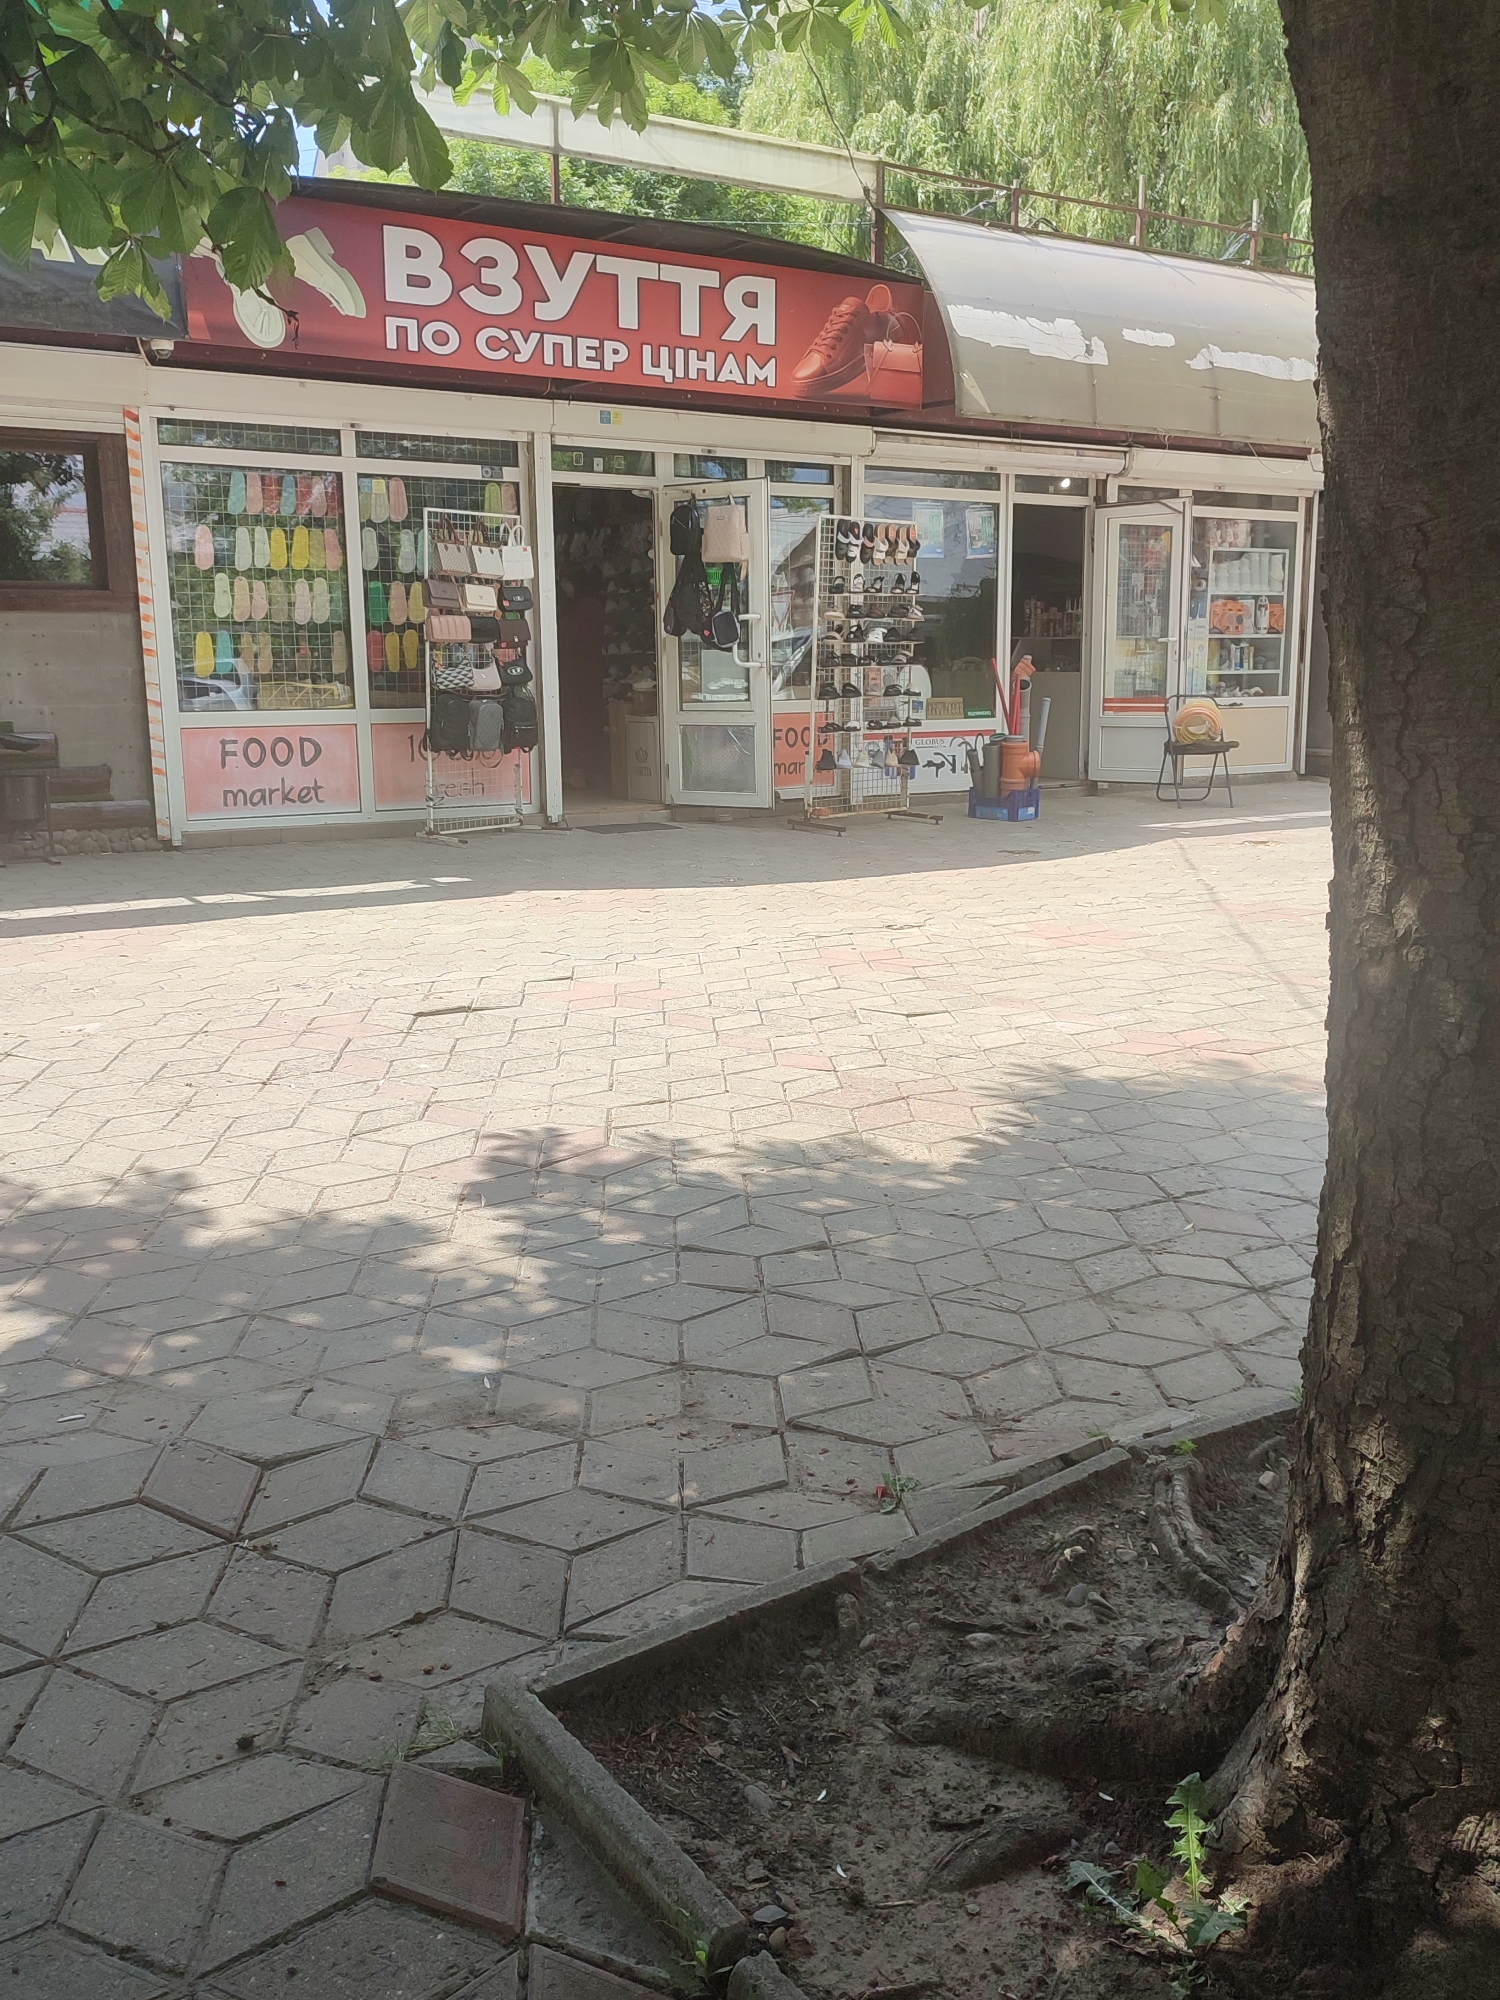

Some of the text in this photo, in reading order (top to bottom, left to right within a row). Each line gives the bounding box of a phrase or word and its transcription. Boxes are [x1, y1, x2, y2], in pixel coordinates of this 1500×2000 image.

[382, 224, 777, 346] ВЗУТТЯ
[385, 316, 777, 387] ПО СУПЕР ЦІНАМ
[219, 736, 323, 769] FOOD
[915, 738, 945, 746] GLOBUS
[222, 776, 325, 807] market
